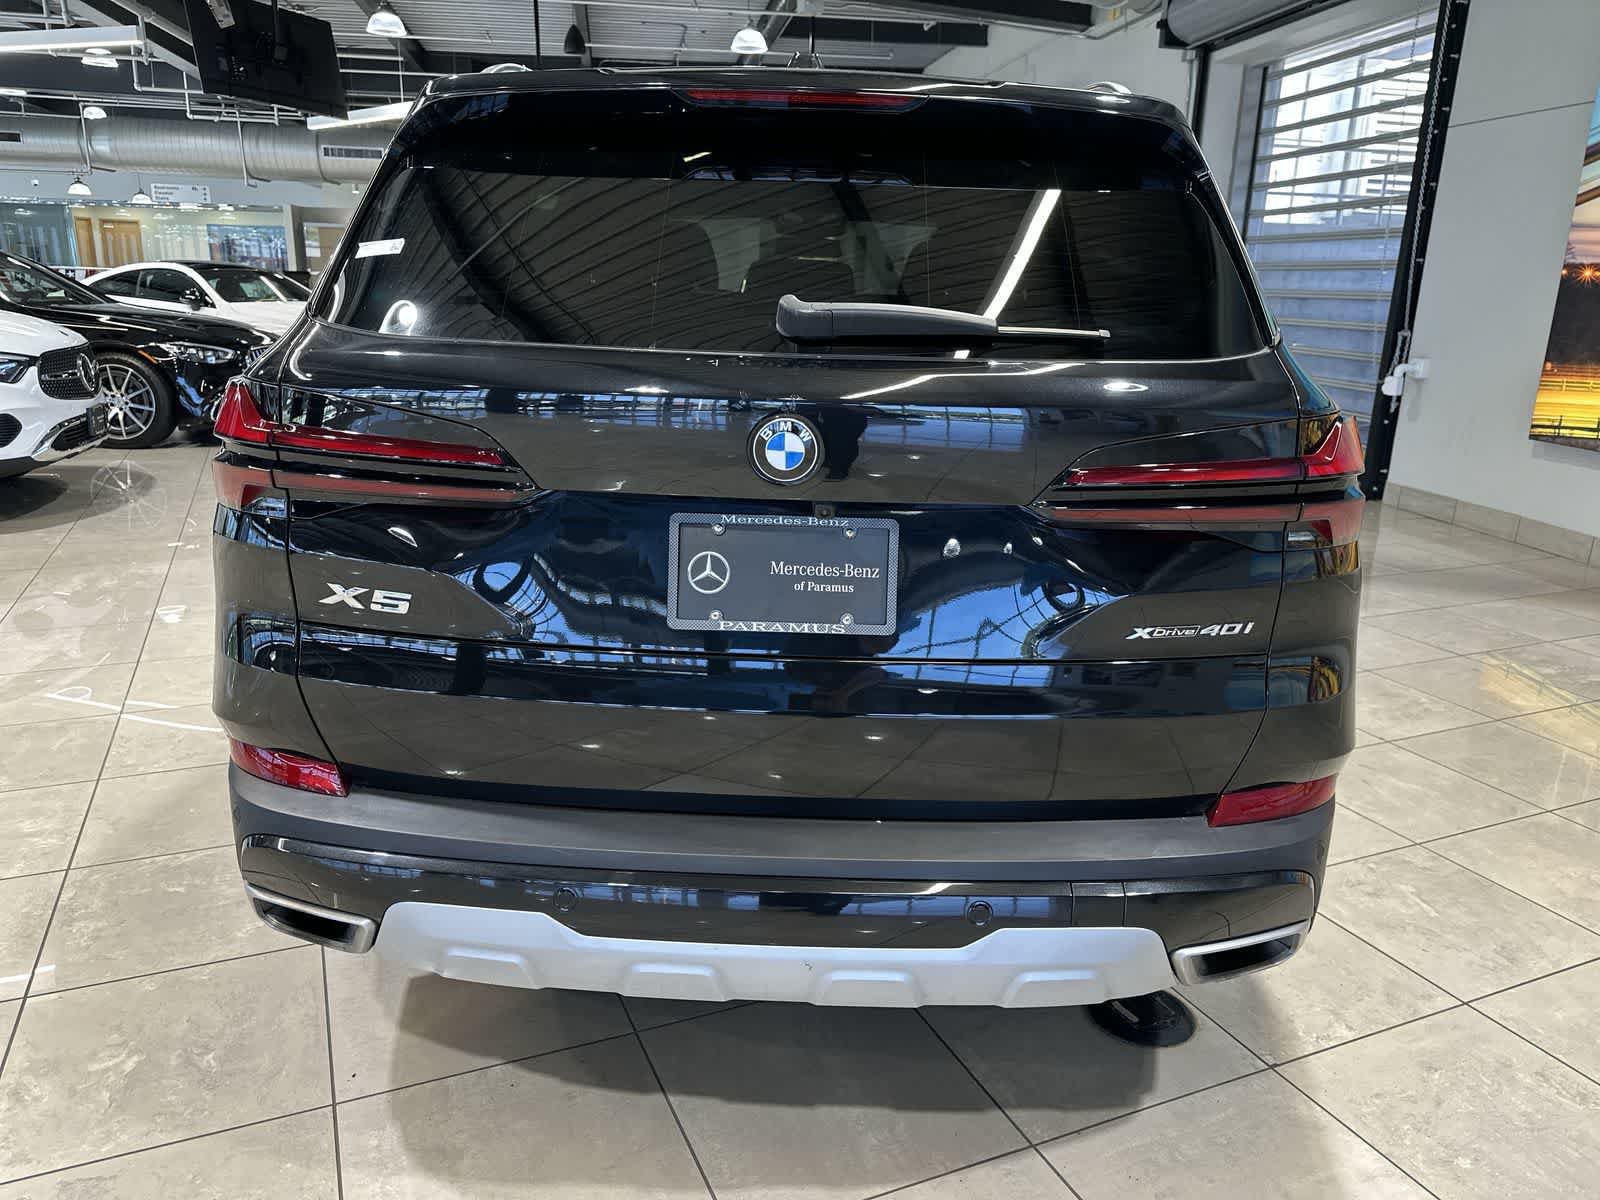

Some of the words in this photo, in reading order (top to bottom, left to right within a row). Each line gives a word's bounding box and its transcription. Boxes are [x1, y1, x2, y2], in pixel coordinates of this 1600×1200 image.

[760, 420, 812, 442] BMW
[720, 514, 849, 527] Mercedes-Benz
[770, 561, 880, 578] Mercedes-Benz
[794, 582, 805, 594] of
[807, 582, 855, 593] Paramus
[318, 582, 413, 614] X5
[719, 621, 846, 634] PARAMUS
